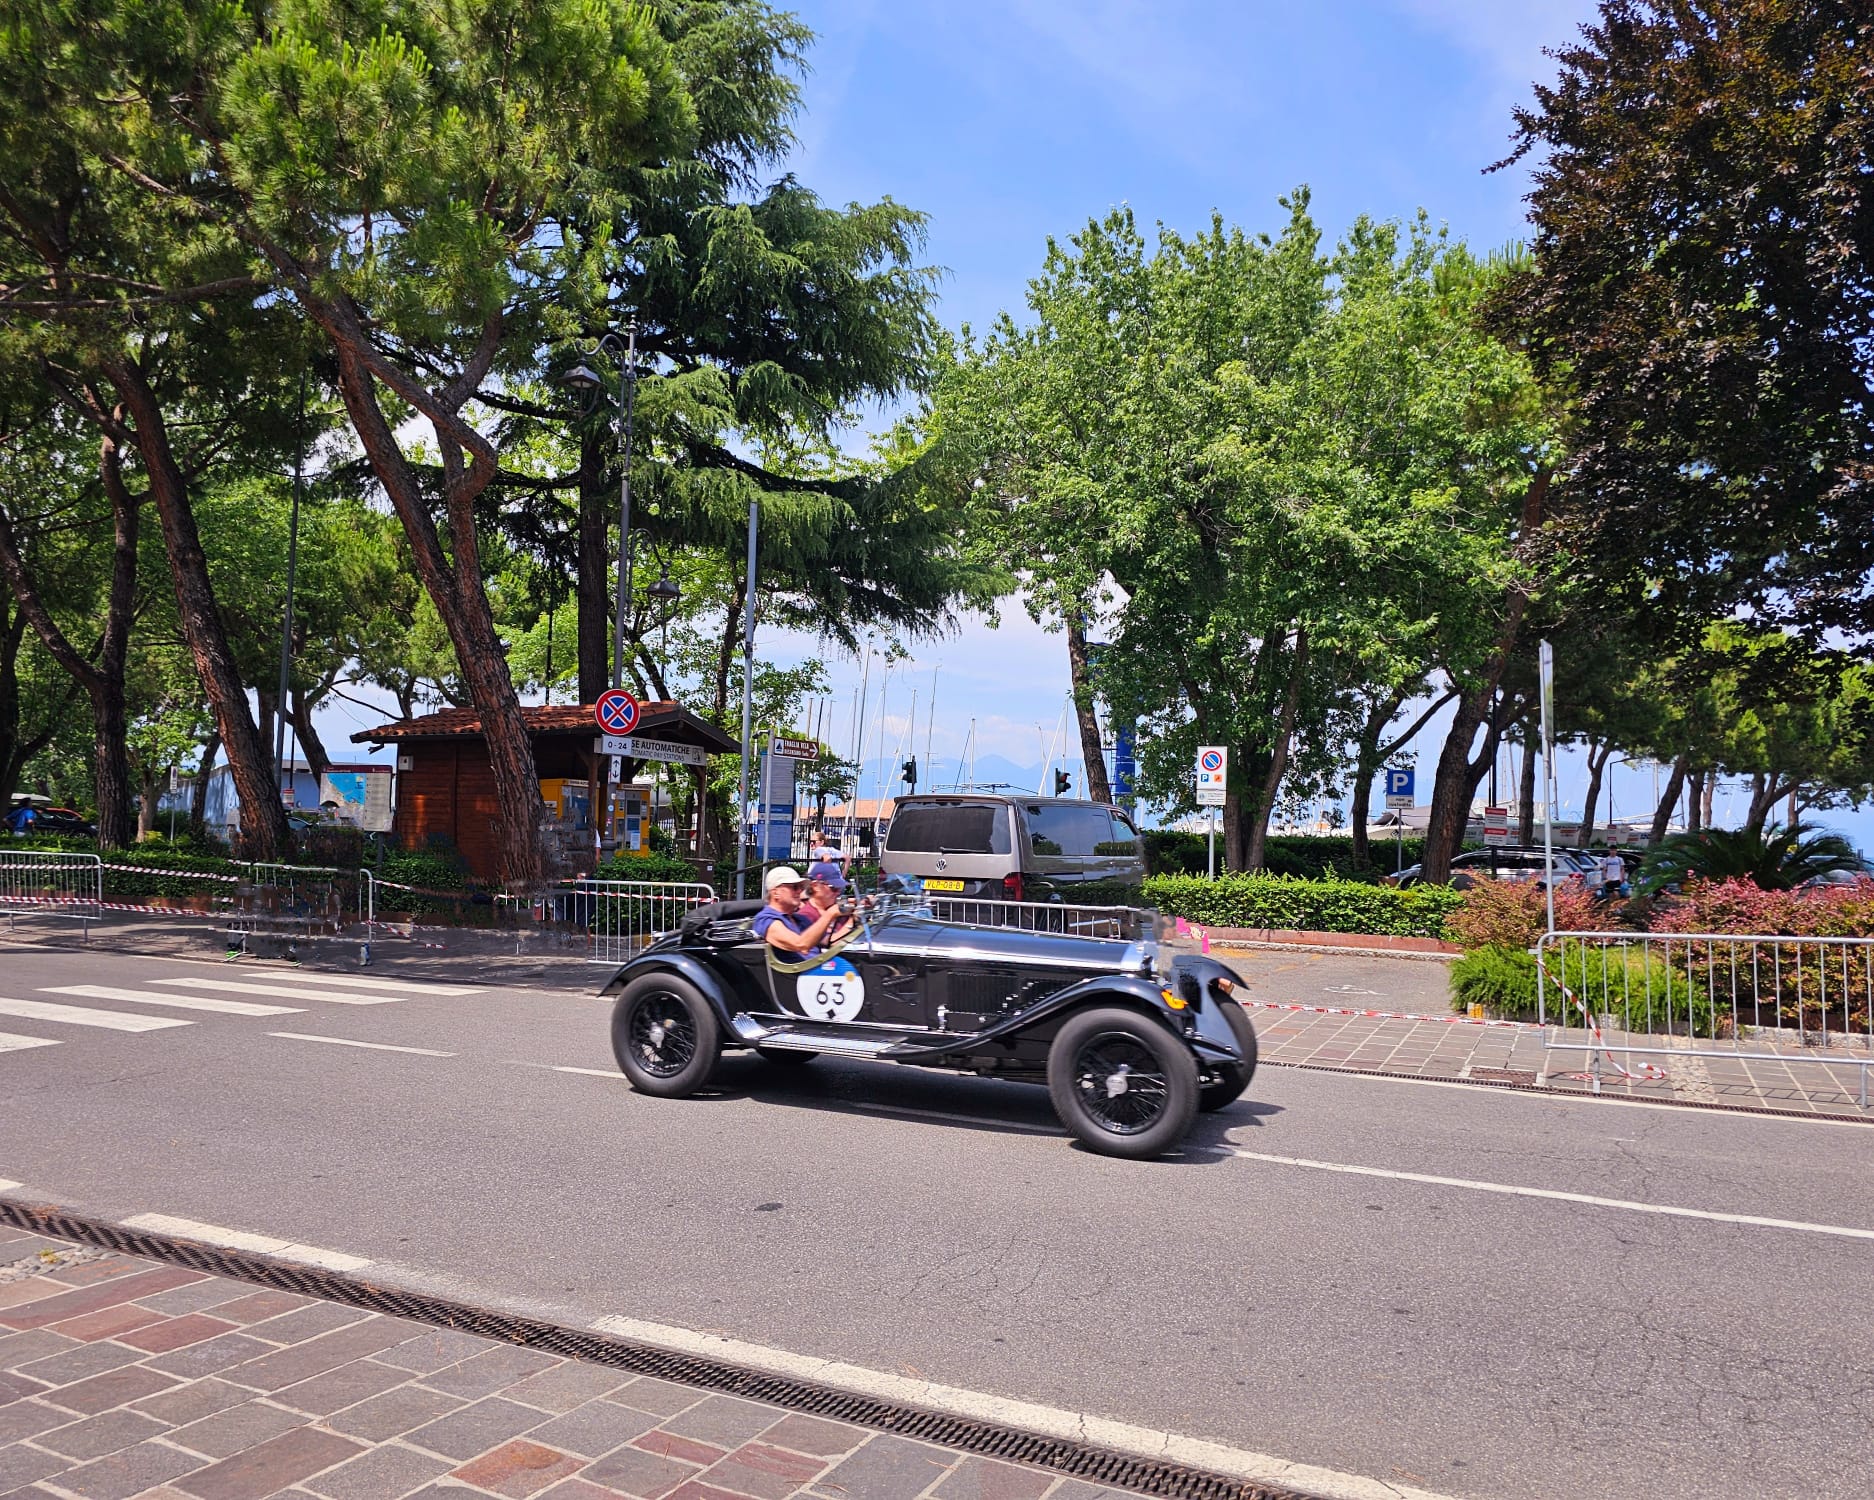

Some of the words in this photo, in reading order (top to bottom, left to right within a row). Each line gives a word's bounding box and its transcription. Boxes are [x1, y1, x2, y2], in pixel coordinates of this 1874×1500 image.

[640, 742, 690, 754] AUTOMATICHE
[663, 753, 685, 761] STATIONS
[1393, 774, 1408, 792] P
[816, 982, 845, 1006] 63
